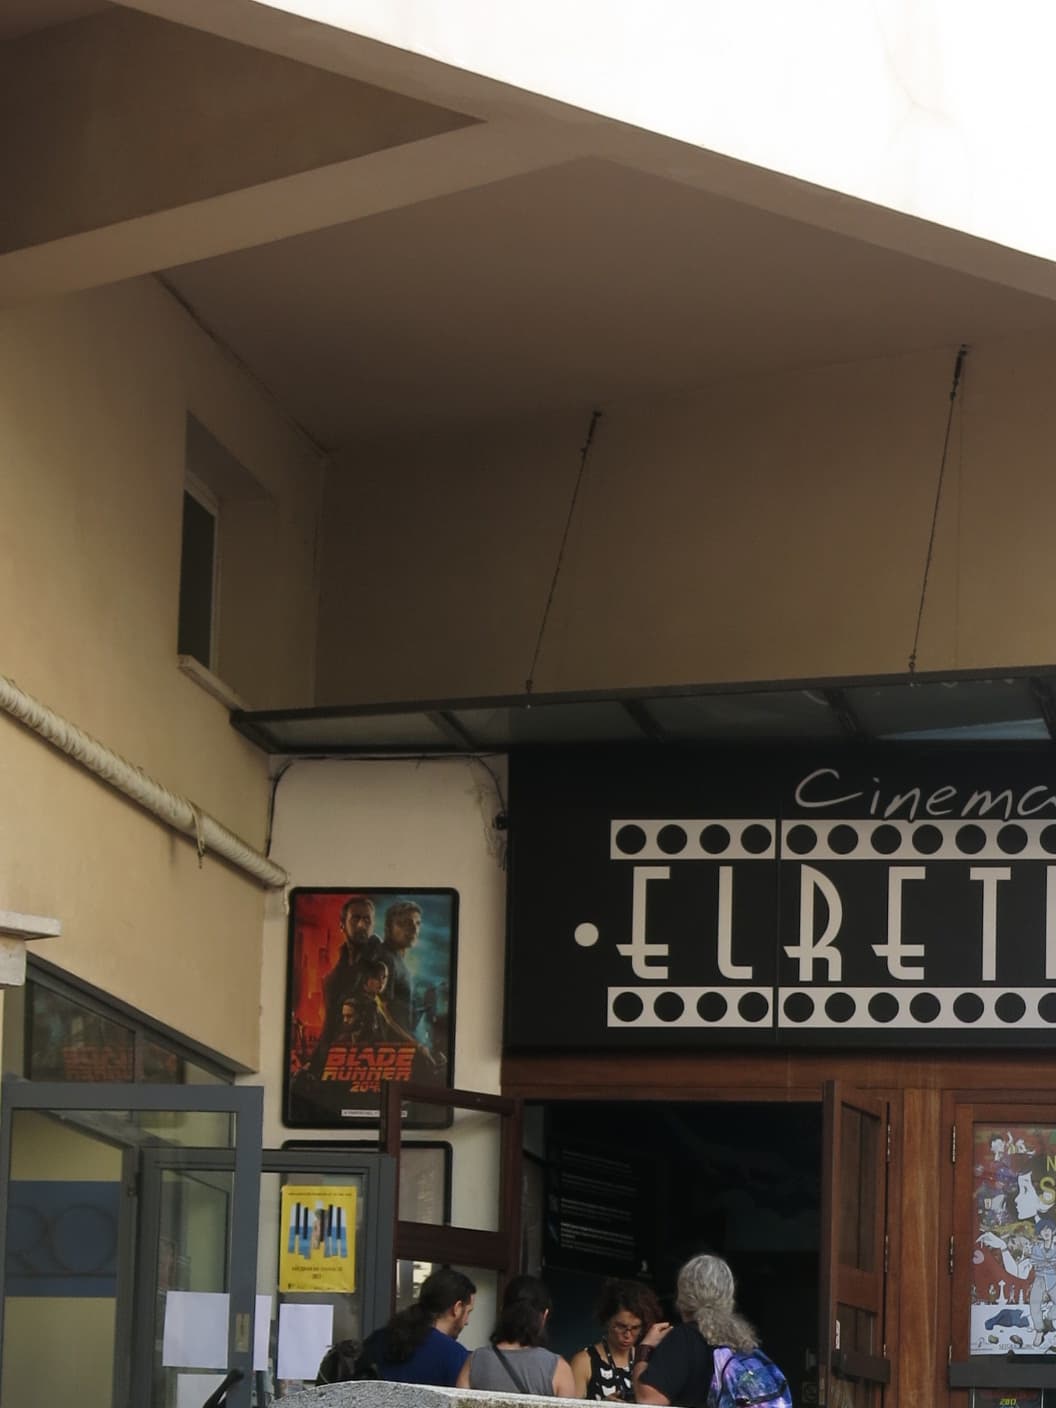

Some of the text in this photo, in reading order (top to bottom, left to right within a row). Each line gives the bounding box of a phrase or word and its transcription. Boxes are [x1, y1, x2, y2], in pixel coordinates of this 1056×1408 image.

[616, 864, 754, 980] EL
[325, 1047, 416, 1067] BLADE
[321, 1067, 412, 1081] RUNNER
